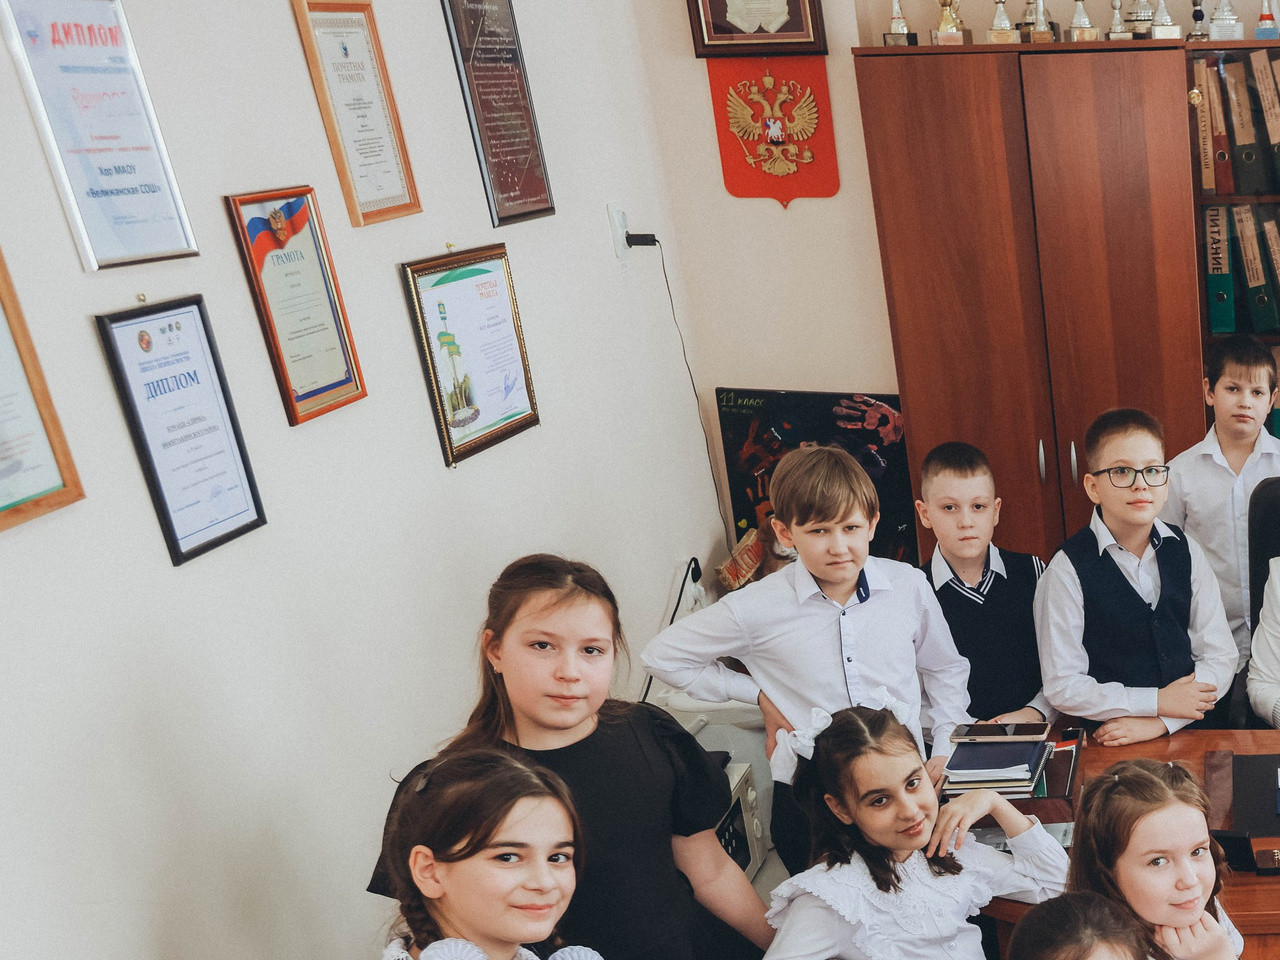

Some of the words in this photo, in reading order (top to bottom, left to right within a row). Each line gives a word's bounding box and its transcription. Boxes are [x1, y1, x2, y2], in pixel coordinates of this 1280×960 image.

[50, 21, 123, 49] ДИПЛОМ
[332, 61, 365, 73] ПОЧЕТНАЯ
[338, 73, 366, 84] ГРАМОТА
[98, 166, 113, 177] Хор
[114, 165, 137, 176] МАОУ
[1208, 208, 1223, 274] ПИТАНИЕ
[271, 250, 305, 267] ГРАМОТА
[144, 370, 201, 402] ДИПЛОМ
[719, 391, 736, 406] 11
